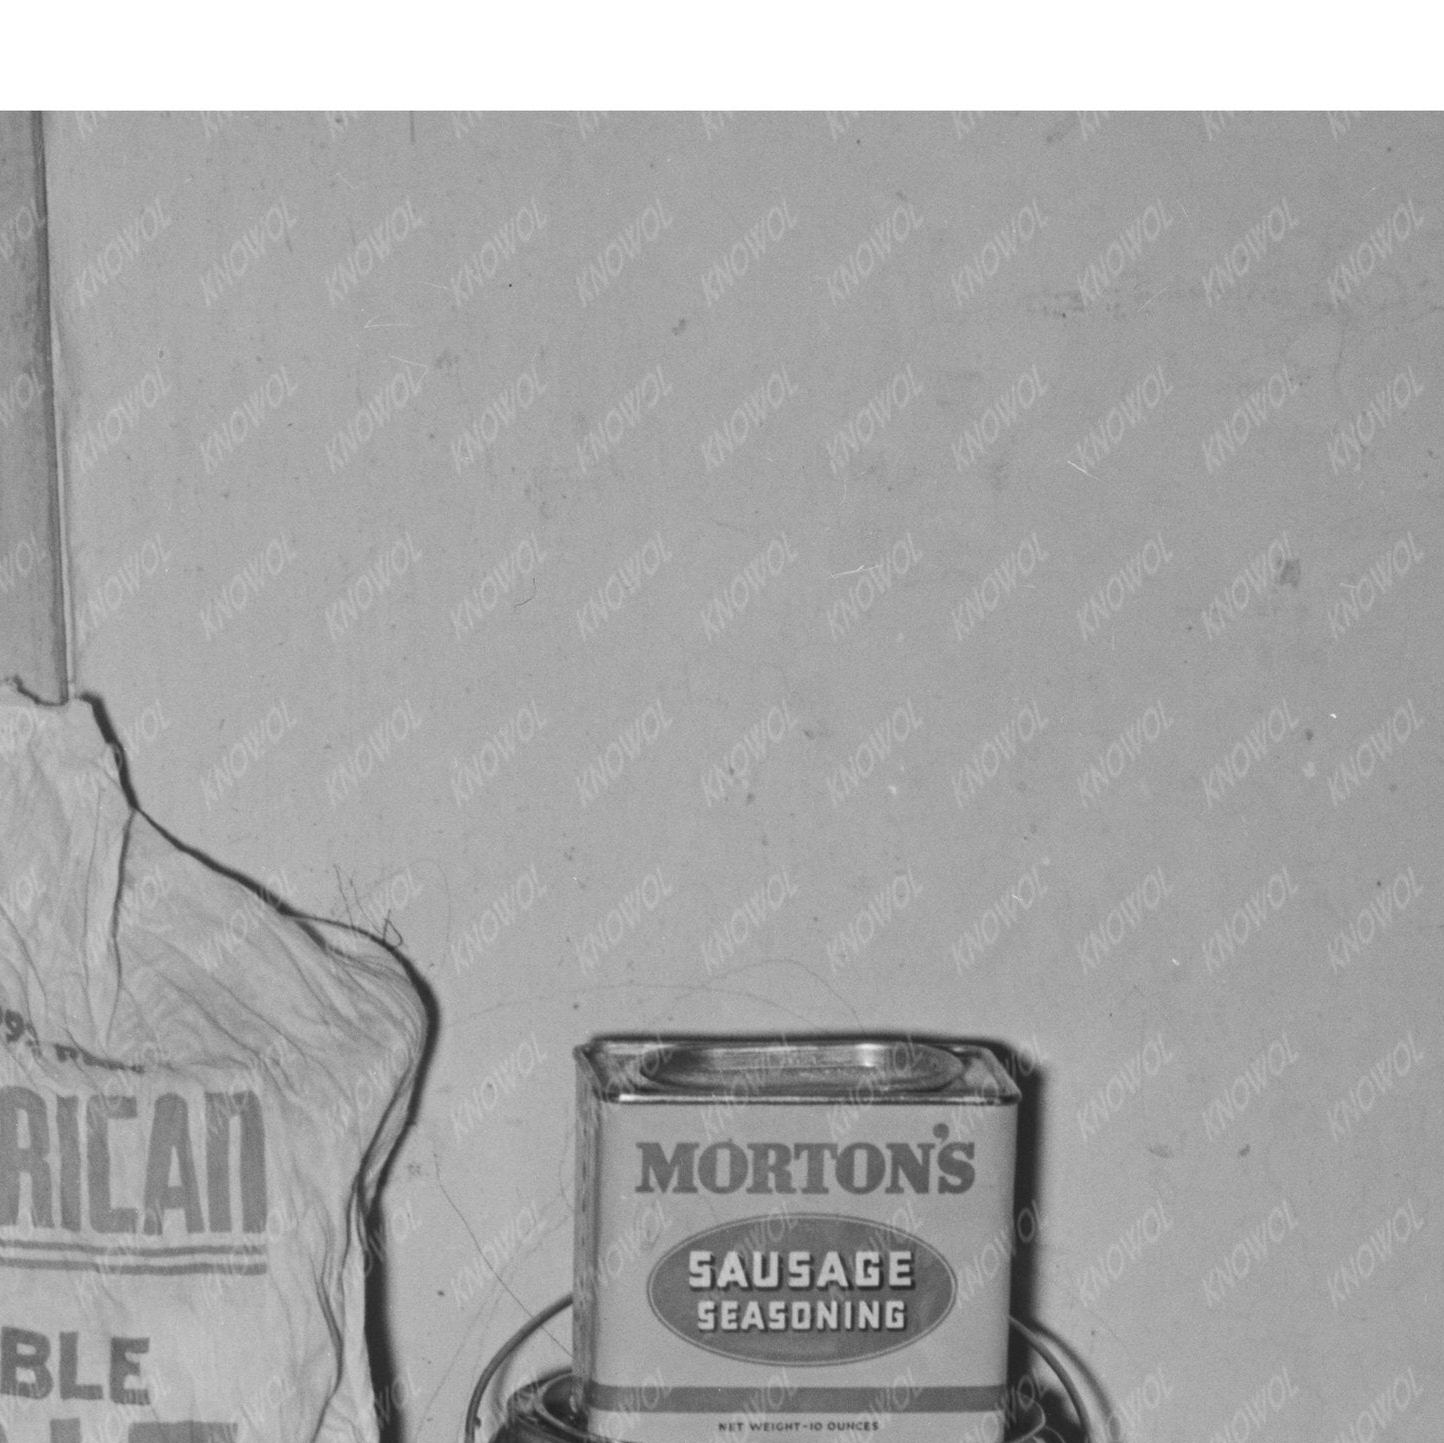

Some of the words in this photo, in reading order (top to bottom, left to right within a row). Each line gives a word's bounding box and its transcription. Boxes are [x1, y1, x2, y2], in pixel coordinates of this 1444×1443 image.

[635, 1122, 976, 1195] MORTON'S
[688, 1249, 914, 1289] SAUSAGE
[696, 1299, 907, 1331] SEASONING
[718, 1422, 744, 1432] NET
[827, 1421, 880, 1431] OUNCES
